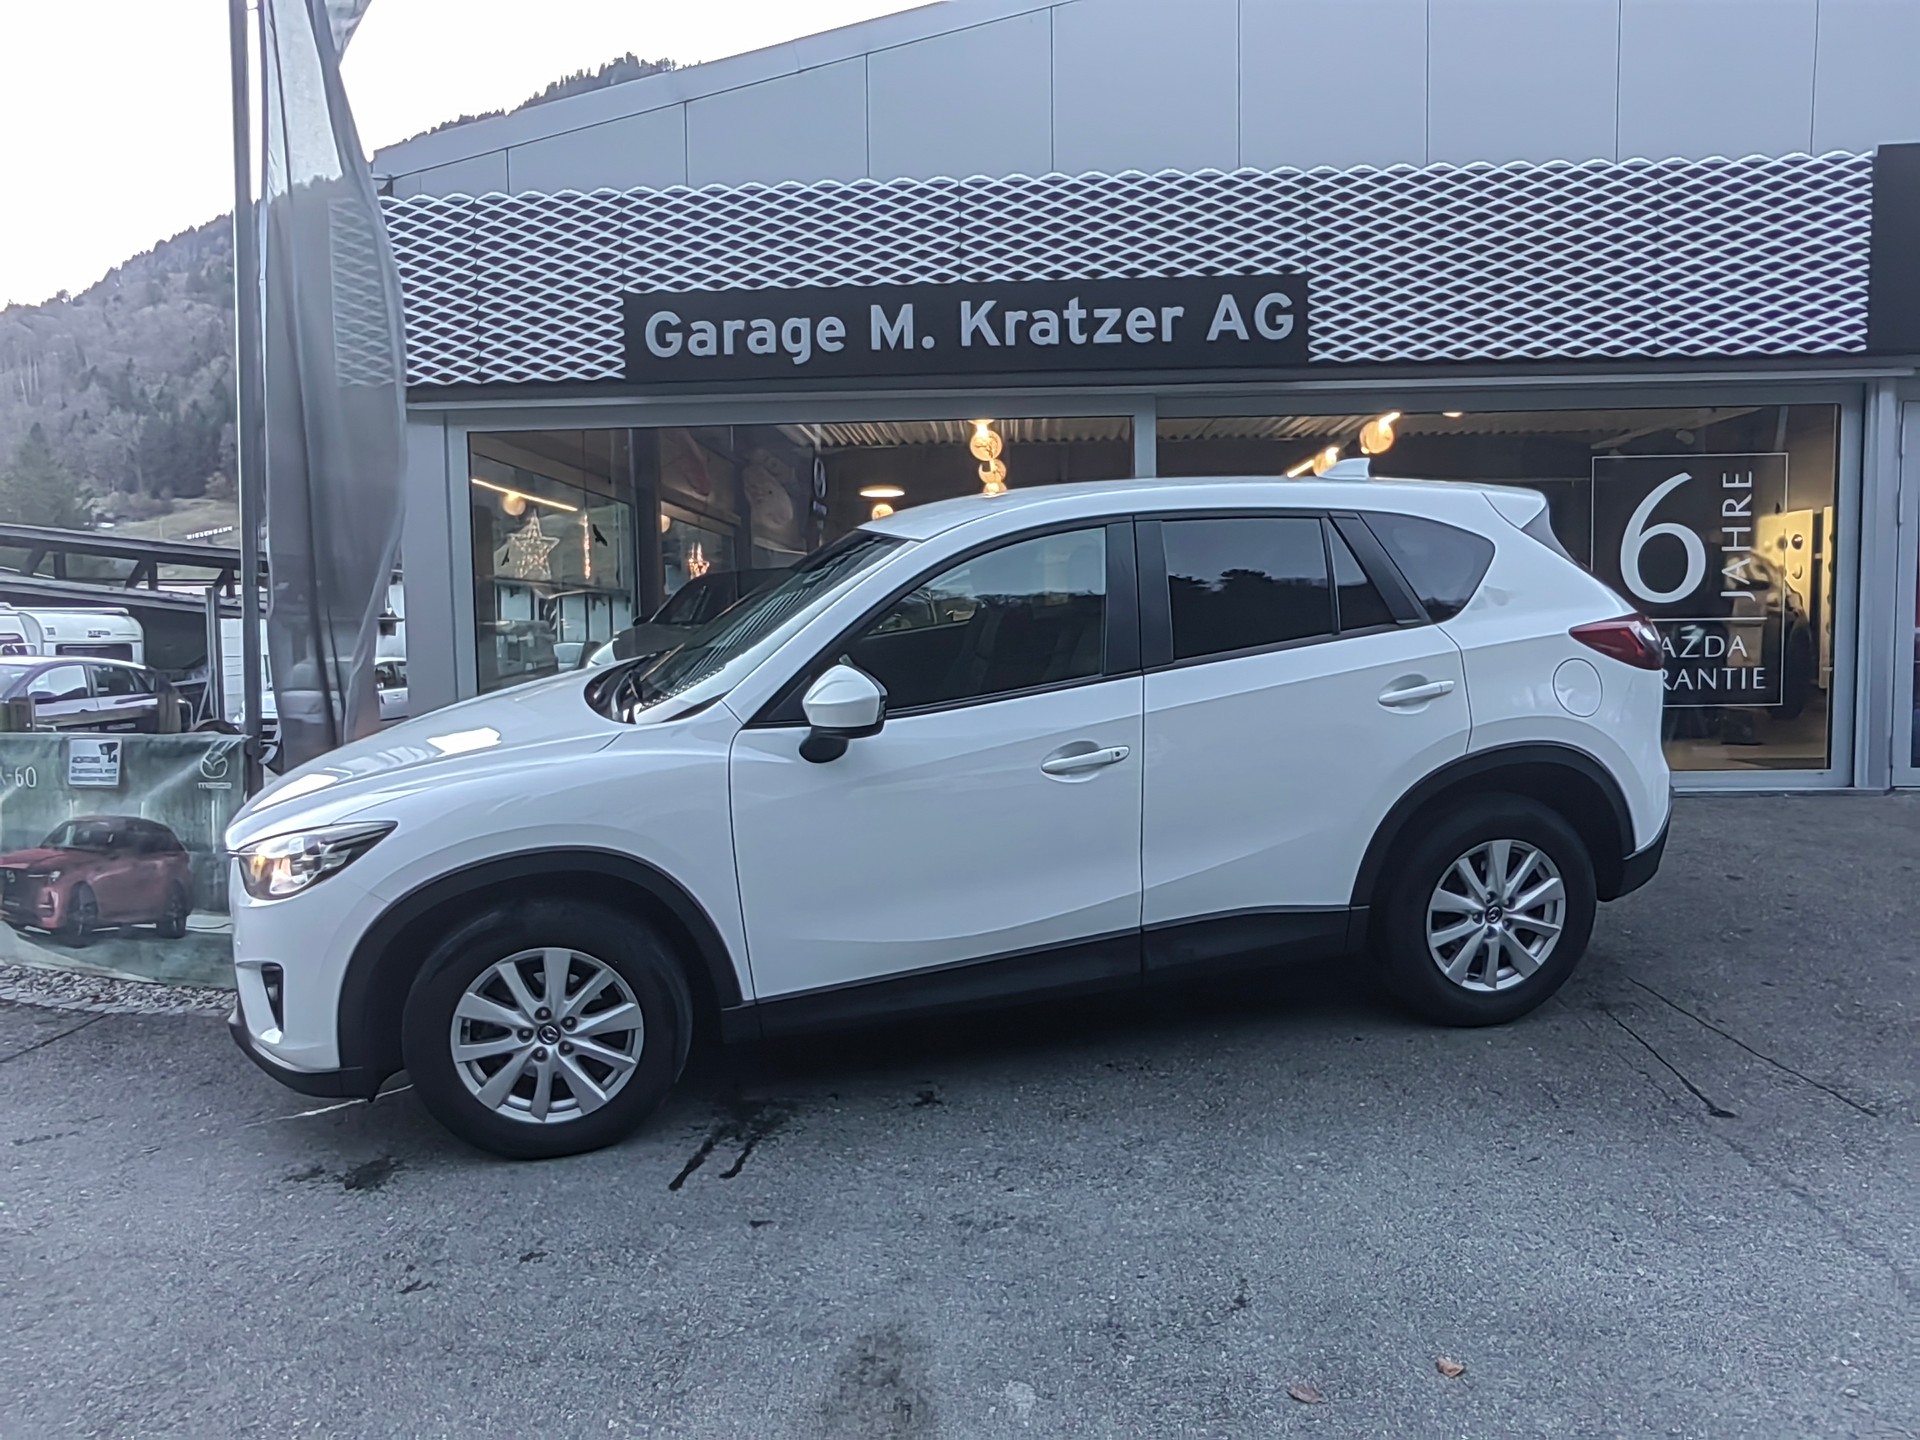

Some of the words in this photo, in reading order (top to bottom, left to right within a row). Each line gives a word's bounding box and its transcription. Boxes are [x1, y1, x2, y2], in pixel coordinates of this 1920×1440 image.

[645, 310, 846, 365] Garage
[870, 303, 935, 350] M.
[960, 296, 1185, 347] Kratzer
[1206, 292, 1294, 341] AG
[1620, 471, 1706, 603] 6
[1720, 471, 1756, 602] JAHRE
